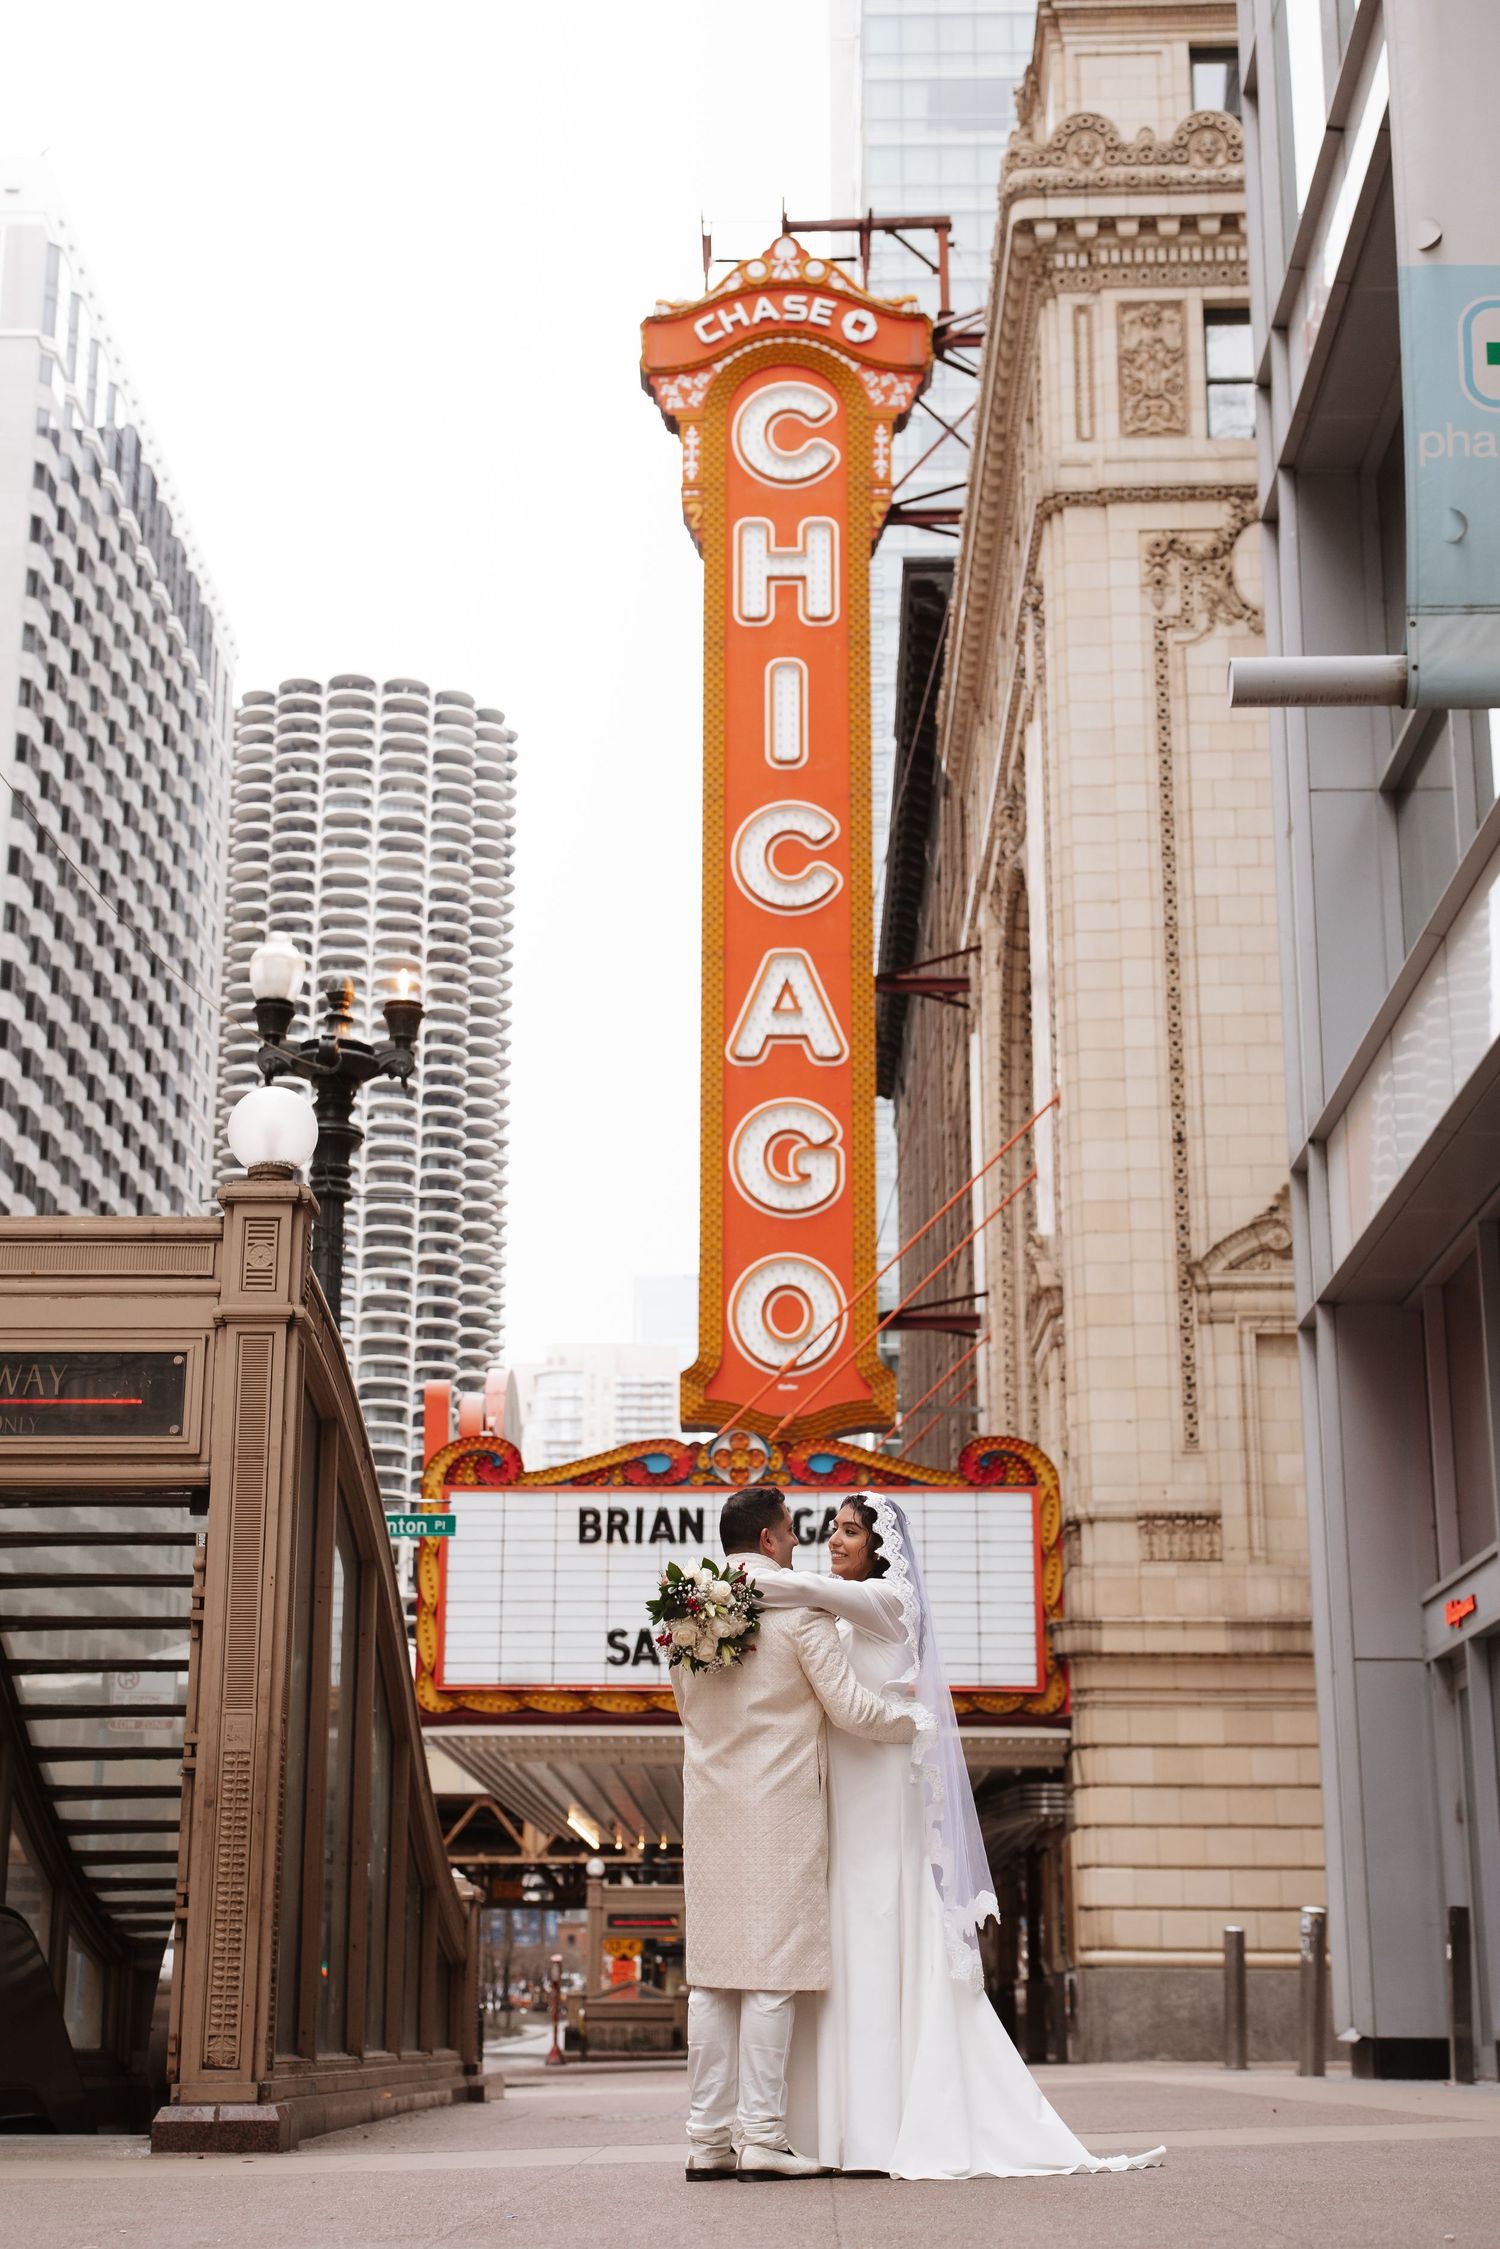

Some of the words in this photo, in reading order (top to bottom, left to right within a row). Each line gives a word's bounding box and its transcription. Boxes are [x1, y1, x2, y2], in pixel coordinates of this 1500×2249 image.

[693, 293, 838, 344] CHASE
[1418, 422, 1498, 467] pha
[725, 381, 850, 1377] CHICAGO
[0, 1364, 69, 1396] WAY
[0, 1415, 40, 1434] NLY
[435, 1520, 446, 1530] Pl
[578, 1506, 704, 1545] BRIAN
[786, 1506, 837, 1546] GA
